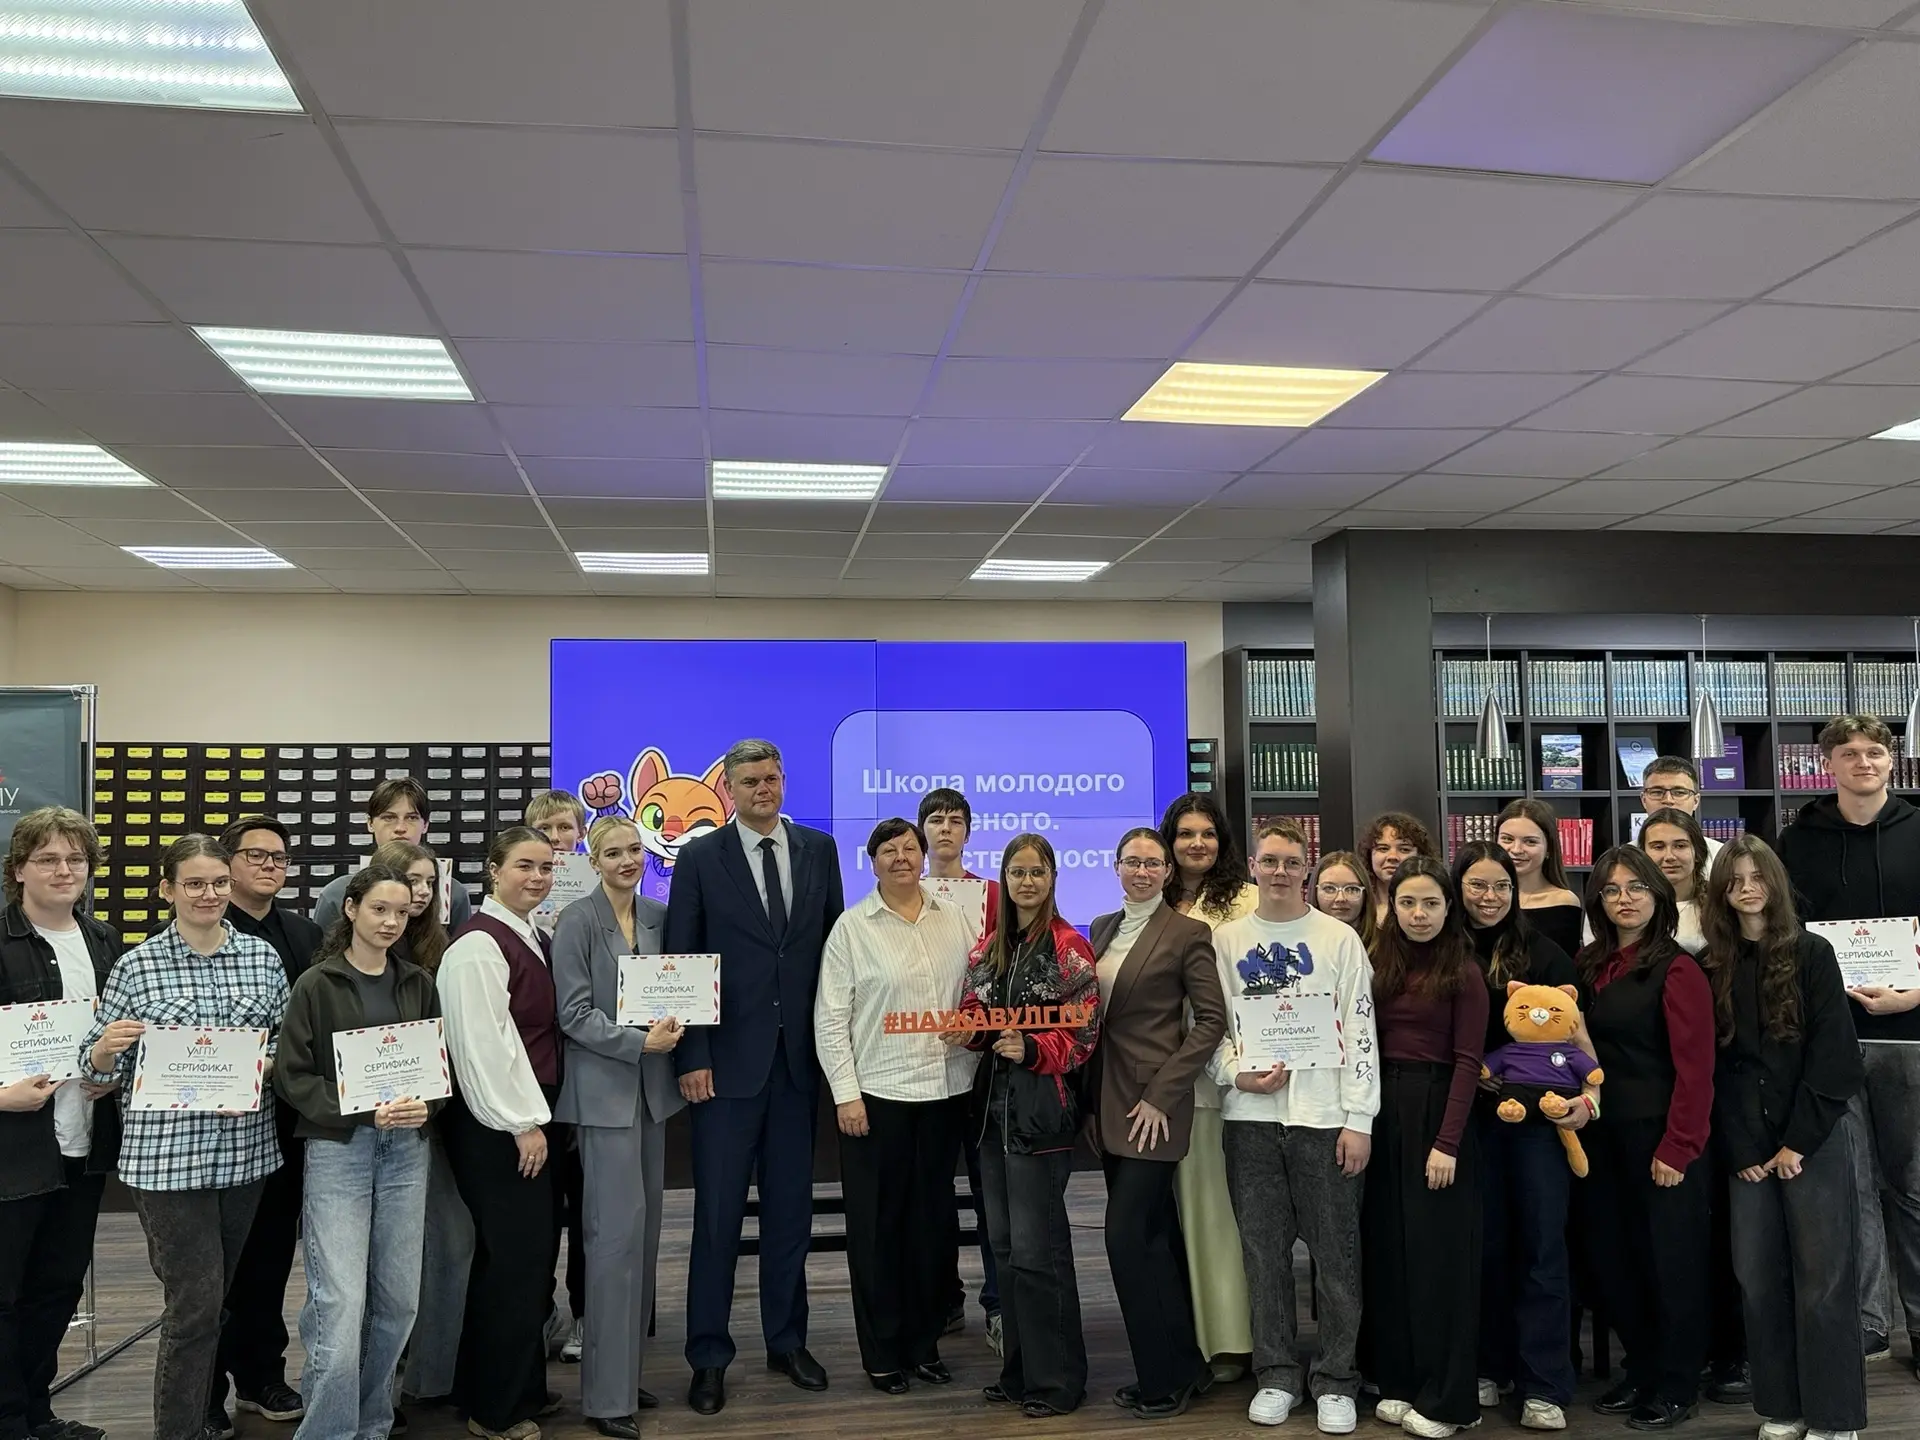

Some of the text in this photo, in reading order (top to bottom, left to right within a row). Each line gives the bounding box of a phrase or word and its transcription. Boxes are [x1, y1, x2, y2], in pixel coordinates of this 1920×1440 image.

[862, 769, 1125, 797] Школа молодого
[971, 811, 1060, 831] еного.
[554, 880, 583, 888] ФИКАТ
[1837, 950, 1894, 960] СЕРТИФИКАТ
[643, 985, 696, 994] СЕРТИФИКАТ
[885, 1004, 1094, 1033] #НАУКАВУЛГПУ
[1261, 1025, 1316, 1036] СЕРТИФИКАТ
[10, 1034, 73, 1050] СЕРТИФИКАТ
[168, 1062, 233, 1072] СЕРТИФИКАТ
[364, 1057, 421, 1073] СЕРТИФИКАТ
